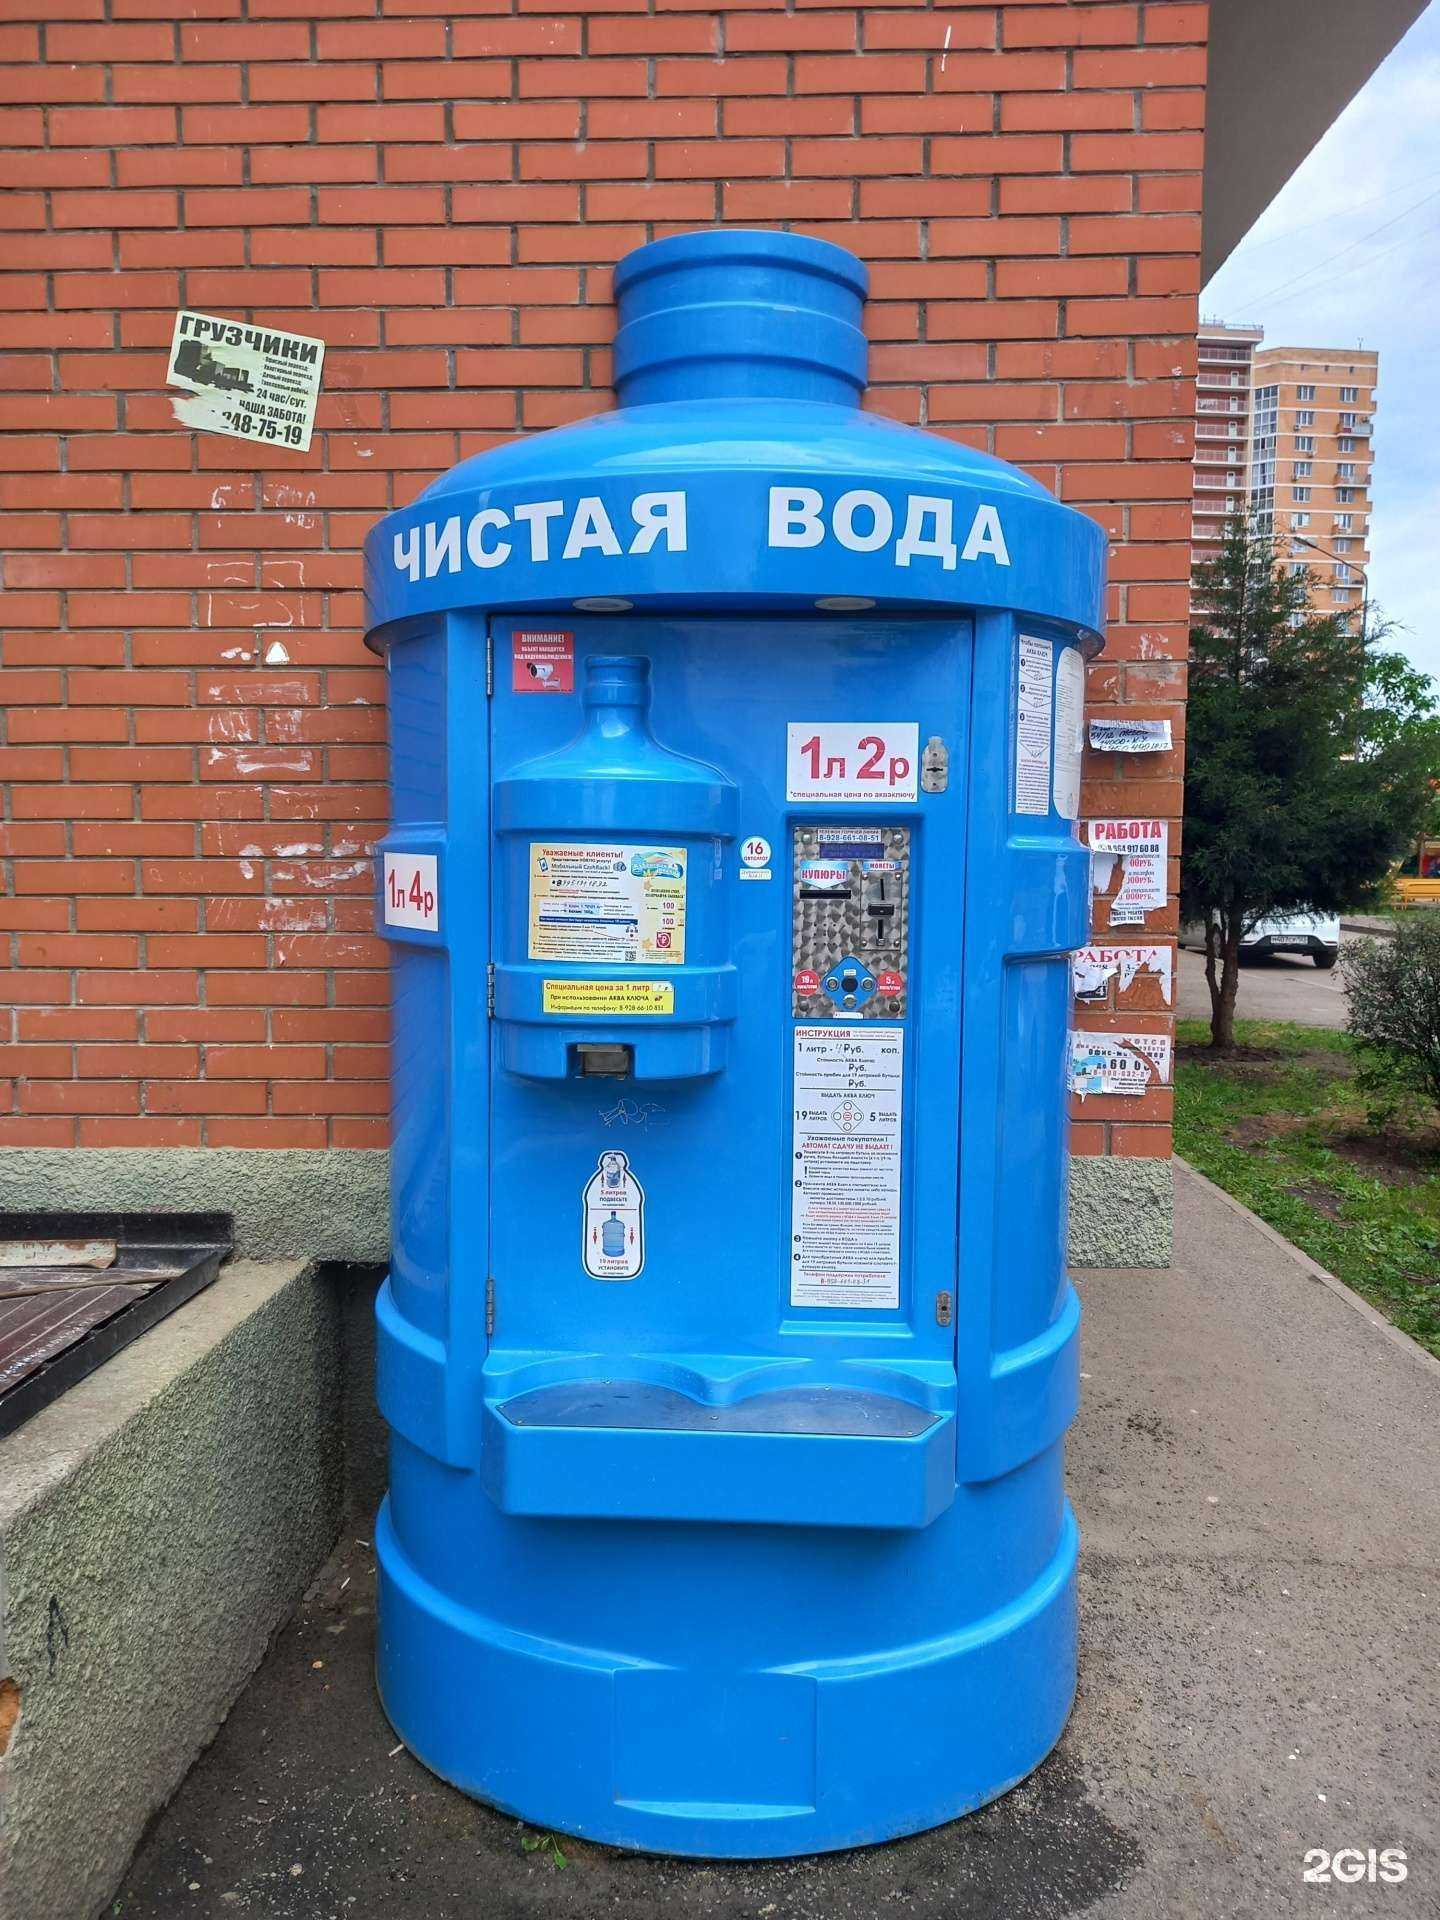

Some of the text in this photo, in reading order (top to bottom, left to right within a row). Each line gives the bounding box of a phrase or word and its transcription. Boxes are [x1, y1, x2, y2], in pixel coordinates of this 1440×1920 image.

[179, 315, 319, 364] ГРУЗЧИКИ
[256, 387, 307, 409] 24 час/сут.
[267, 407, 307, 425] ЗАБОТА!
[392, 491, 688, 581] ЧИСТАЯ
[768, 486, 1011, 570] ВОДА
[800, 736, 910, 786] 1л 2р
[874, 792, 915, 800] акваключу
[1094, 821, 1162, 840] РАБОТА
[542, 848, 624, 859] Уважаемые клиенты!
[747, 842, 763, 855] 16
[869, 862, 895, 870] МОНЕТЫ
[801, 869, 847, 880] КУПЮРЫ
[388, 868, 434, 918] 1л 4р
[662, 902, 675, 910] 100
[546, 982, 594, 991] Специальная
[595, 984, 614, 992] цена
[796, 1029, 851, 1038] ИНСТРУКЦИЯ
[843, 1043, 864, 1055] Руб.
[848, 1064, 867, 1073] Руб.
[848, 1079, 867, 1088] Руб.
[796, 1110, 808, 1121] 19
[869, 1112, 876, 1122] 5
